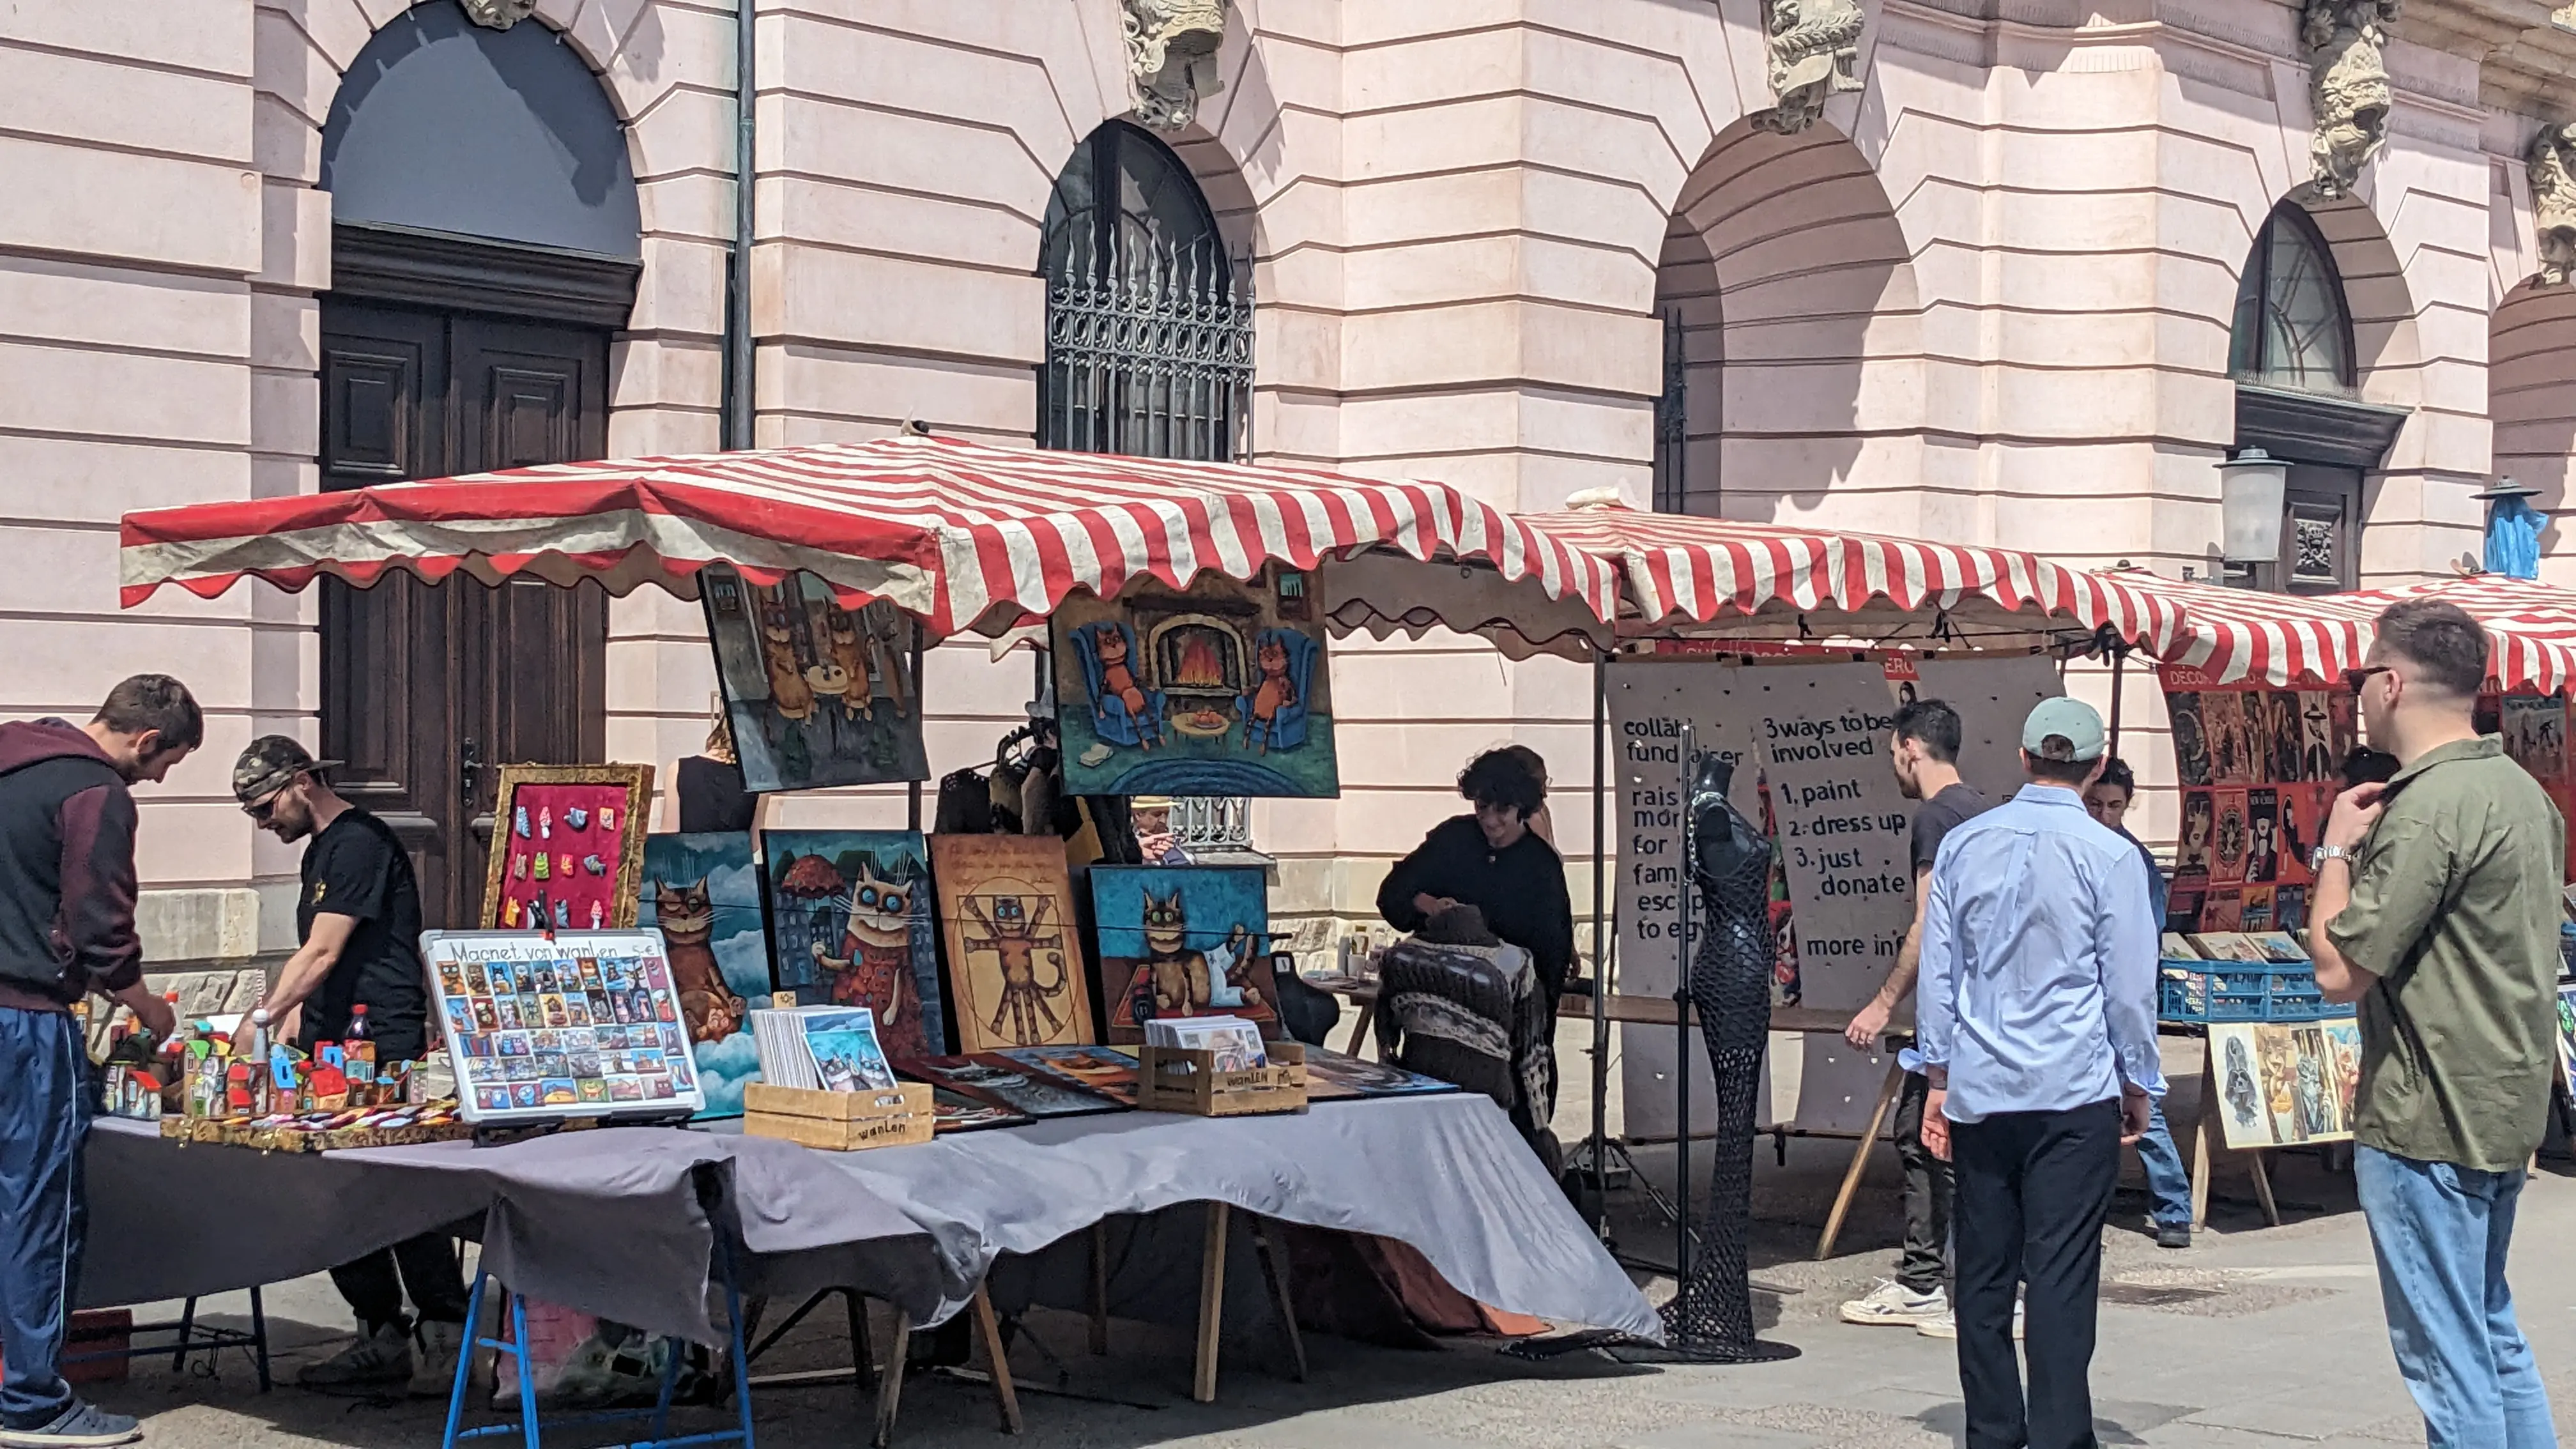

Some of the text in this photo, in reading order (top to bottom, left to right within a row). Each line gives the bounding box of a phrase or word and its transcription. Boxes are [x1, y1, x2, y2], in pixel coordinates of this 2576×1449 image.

[1770, 736, 1873, 763] involved
[1801, 779, 1862, 808] paint
[1811, 815, 1873, 836] dress
[1878, 814, 1906, 836] up
[1632, 834, 1667, 855] for
[1817, 848, 1863, 875] just
[1821, 874, 1906, 895] donate
[1637, 919, 1661, 940] to
[1807, 939, 1866, 956] more
